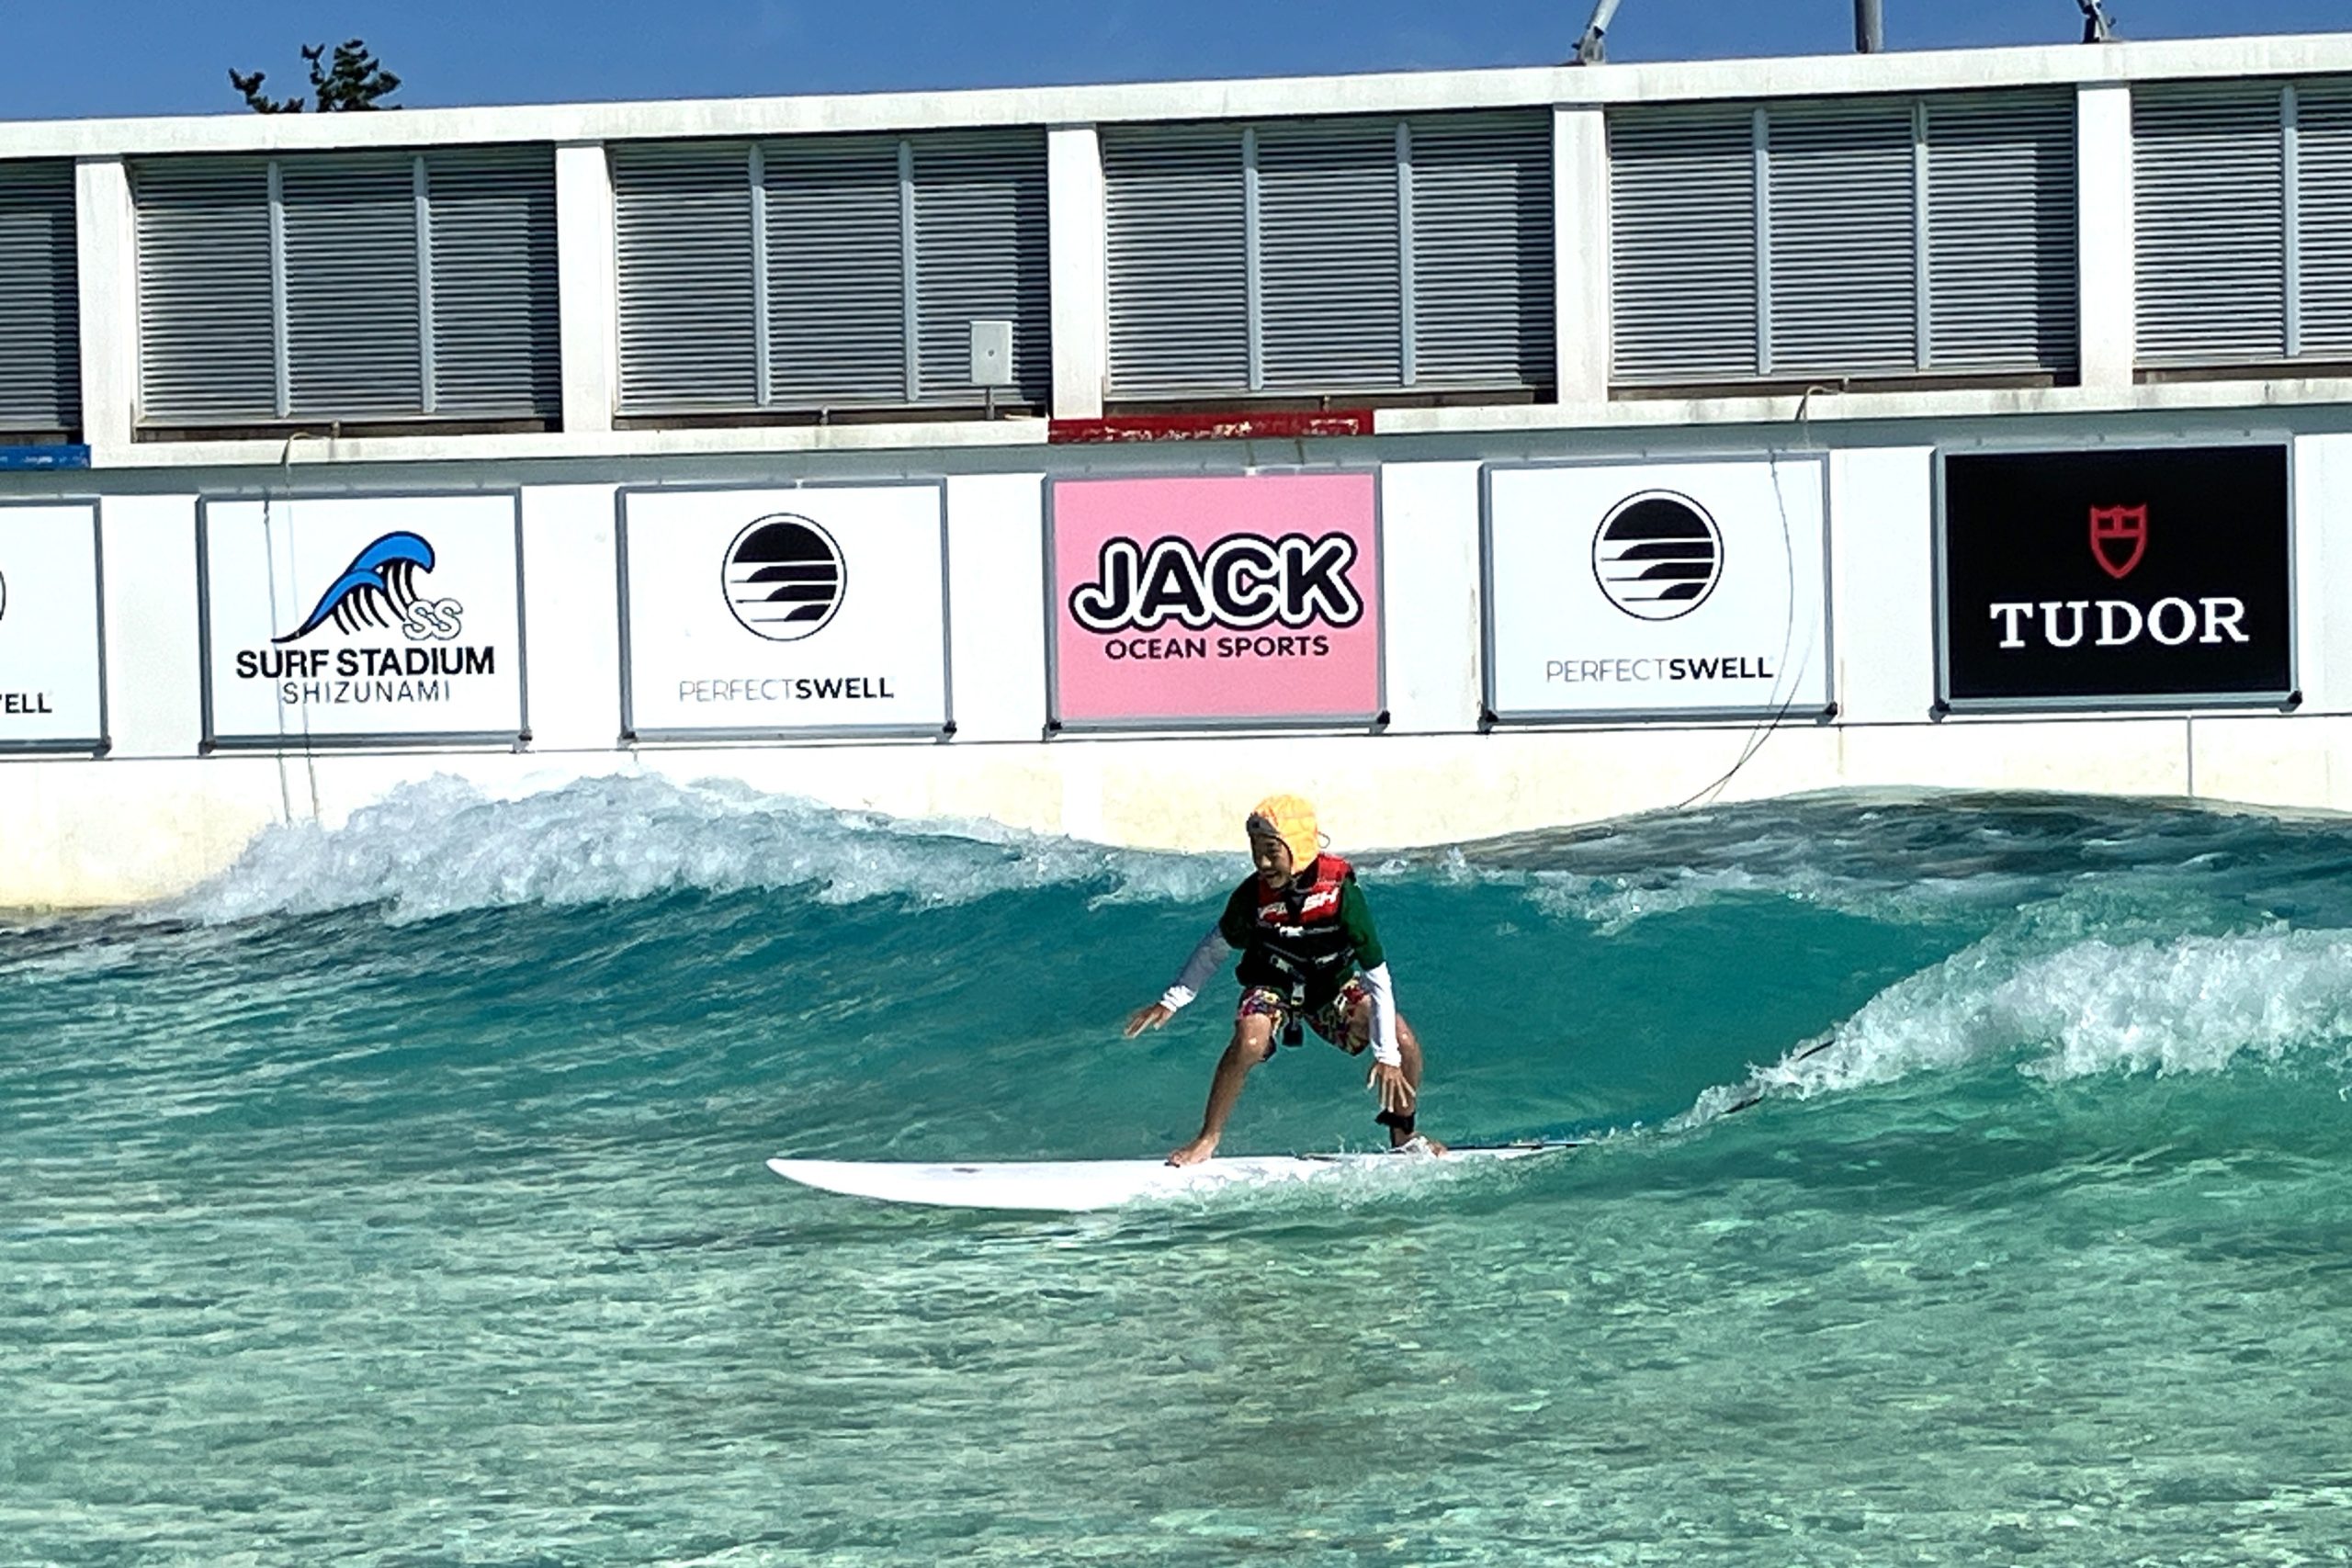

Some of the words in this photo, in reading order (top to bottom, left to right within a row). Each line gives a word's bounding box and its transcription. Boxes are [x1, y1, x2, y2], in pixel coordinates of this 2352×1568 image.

[1069, 531, 1364, 634] JACK
[402, 598, 463, 640] SS
[1989, 597, 2250, 649] TUDOR
[1104, 638, 1206, 660] OCEAN
[1216, 636, 1329, 658] SPORTS
[235, 649, 330, 679] SURF
[336, 646, 495, 677] STADIUM
[1546, 657, 1774, 682] PERFECTSWELL
[0, 692, 53, 714] ELL
[282, 680, 450, 705] SHIZUNAMI
[679, 677, 895, 703] PERFECTSWELL
